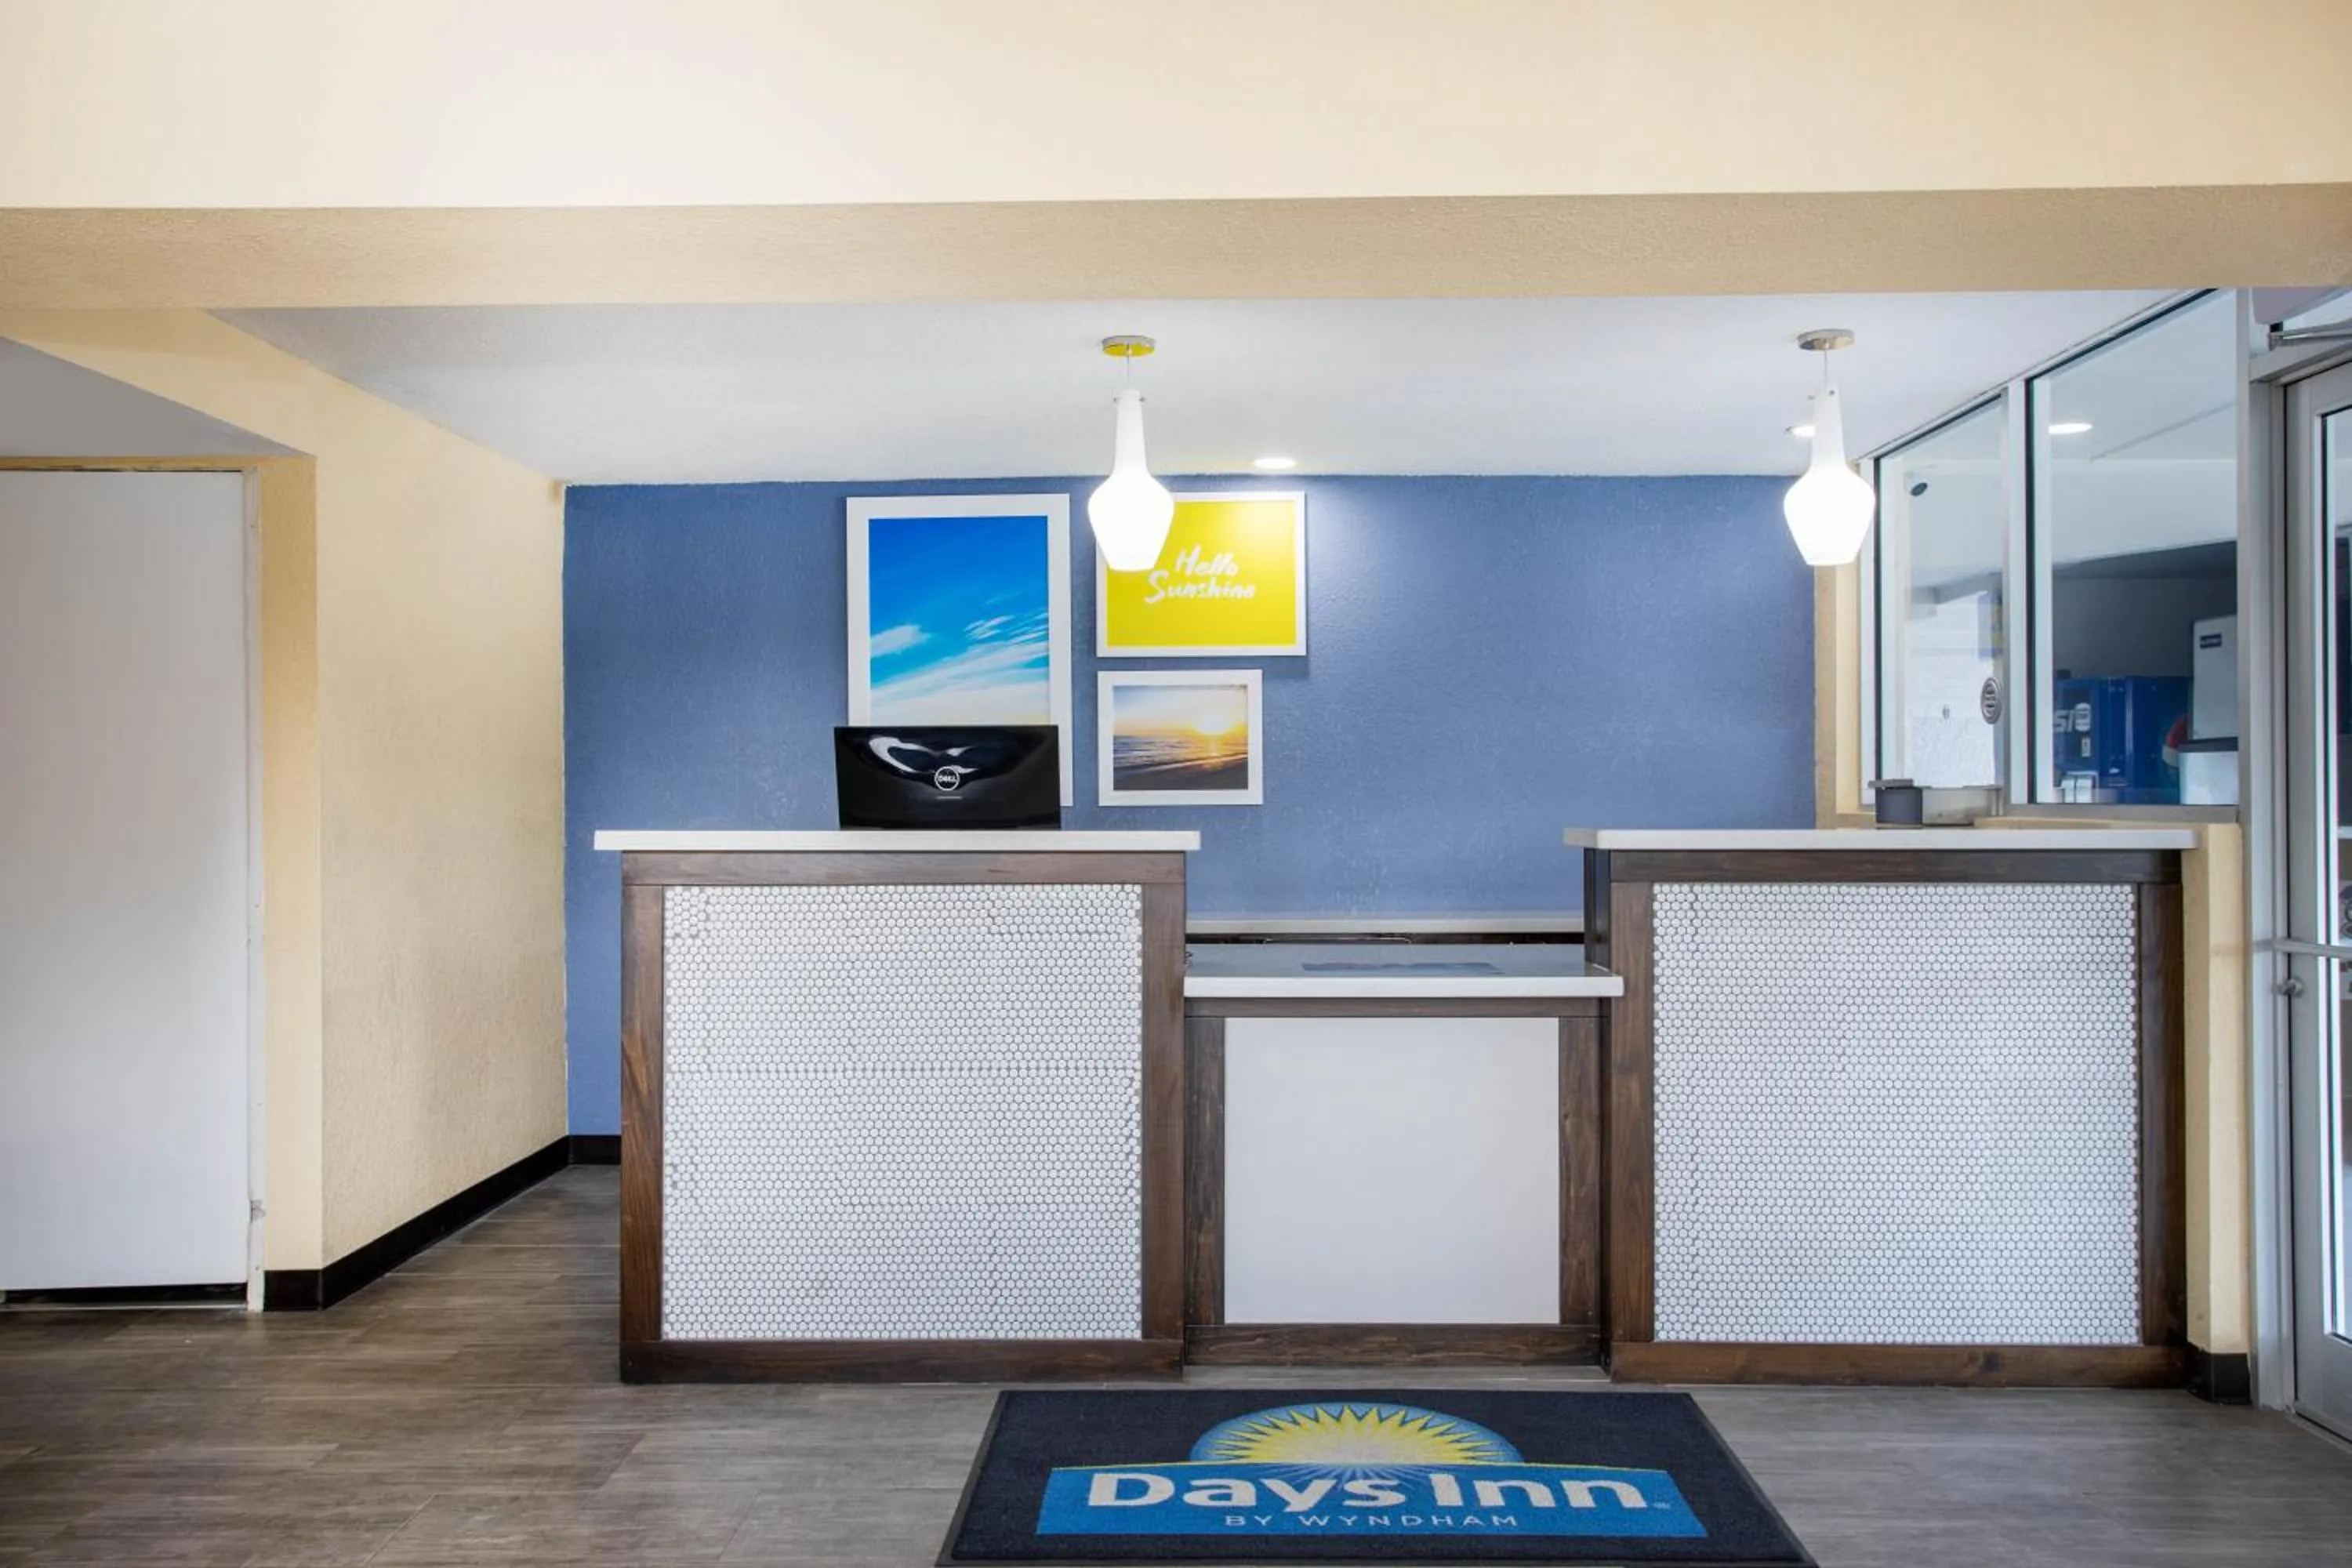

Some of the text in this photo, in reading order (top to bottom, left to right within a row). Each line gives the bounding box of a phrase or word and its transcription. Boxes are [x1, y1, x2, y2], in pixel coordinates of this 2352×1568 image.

[1176, 544, 1239, 576] Hello
[1144, 570, 1255, 604] Sunshine
[1087, 1473, 1648, 1512] Days Inn
[1225, 1515, 1519, 1526] BY WYNDHAM
